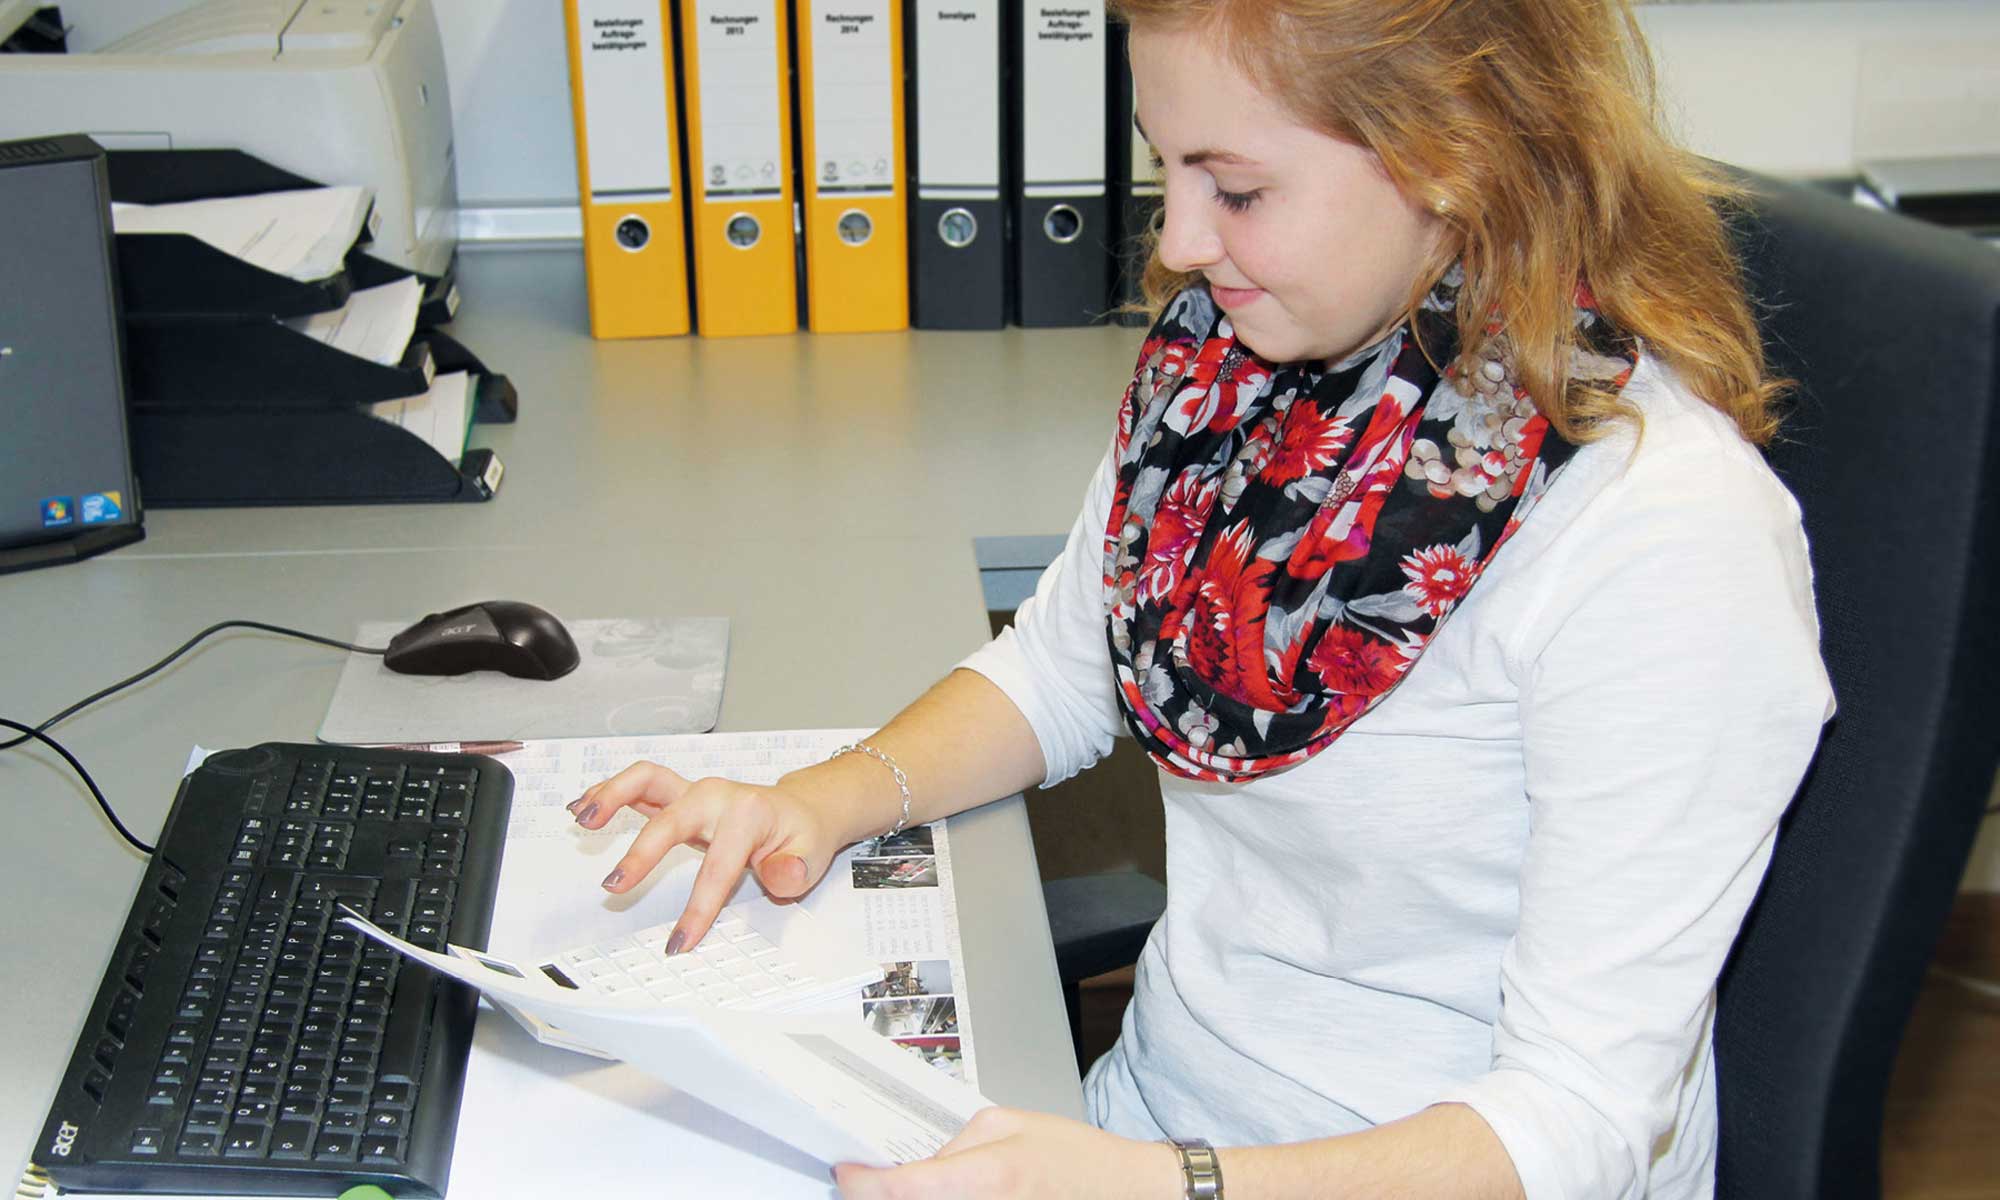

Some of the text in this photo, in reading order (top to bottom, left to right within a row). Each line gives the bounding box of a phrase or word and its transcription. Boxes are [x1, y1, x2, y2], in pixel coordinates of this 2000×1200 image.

[1040, 8, 1091, 18] Bestellungen
[710, 15, 758, 25] Rechnungen
[825, 14, 873, 24] Rechnungen
[52, 1121, 79, 1157] acer
